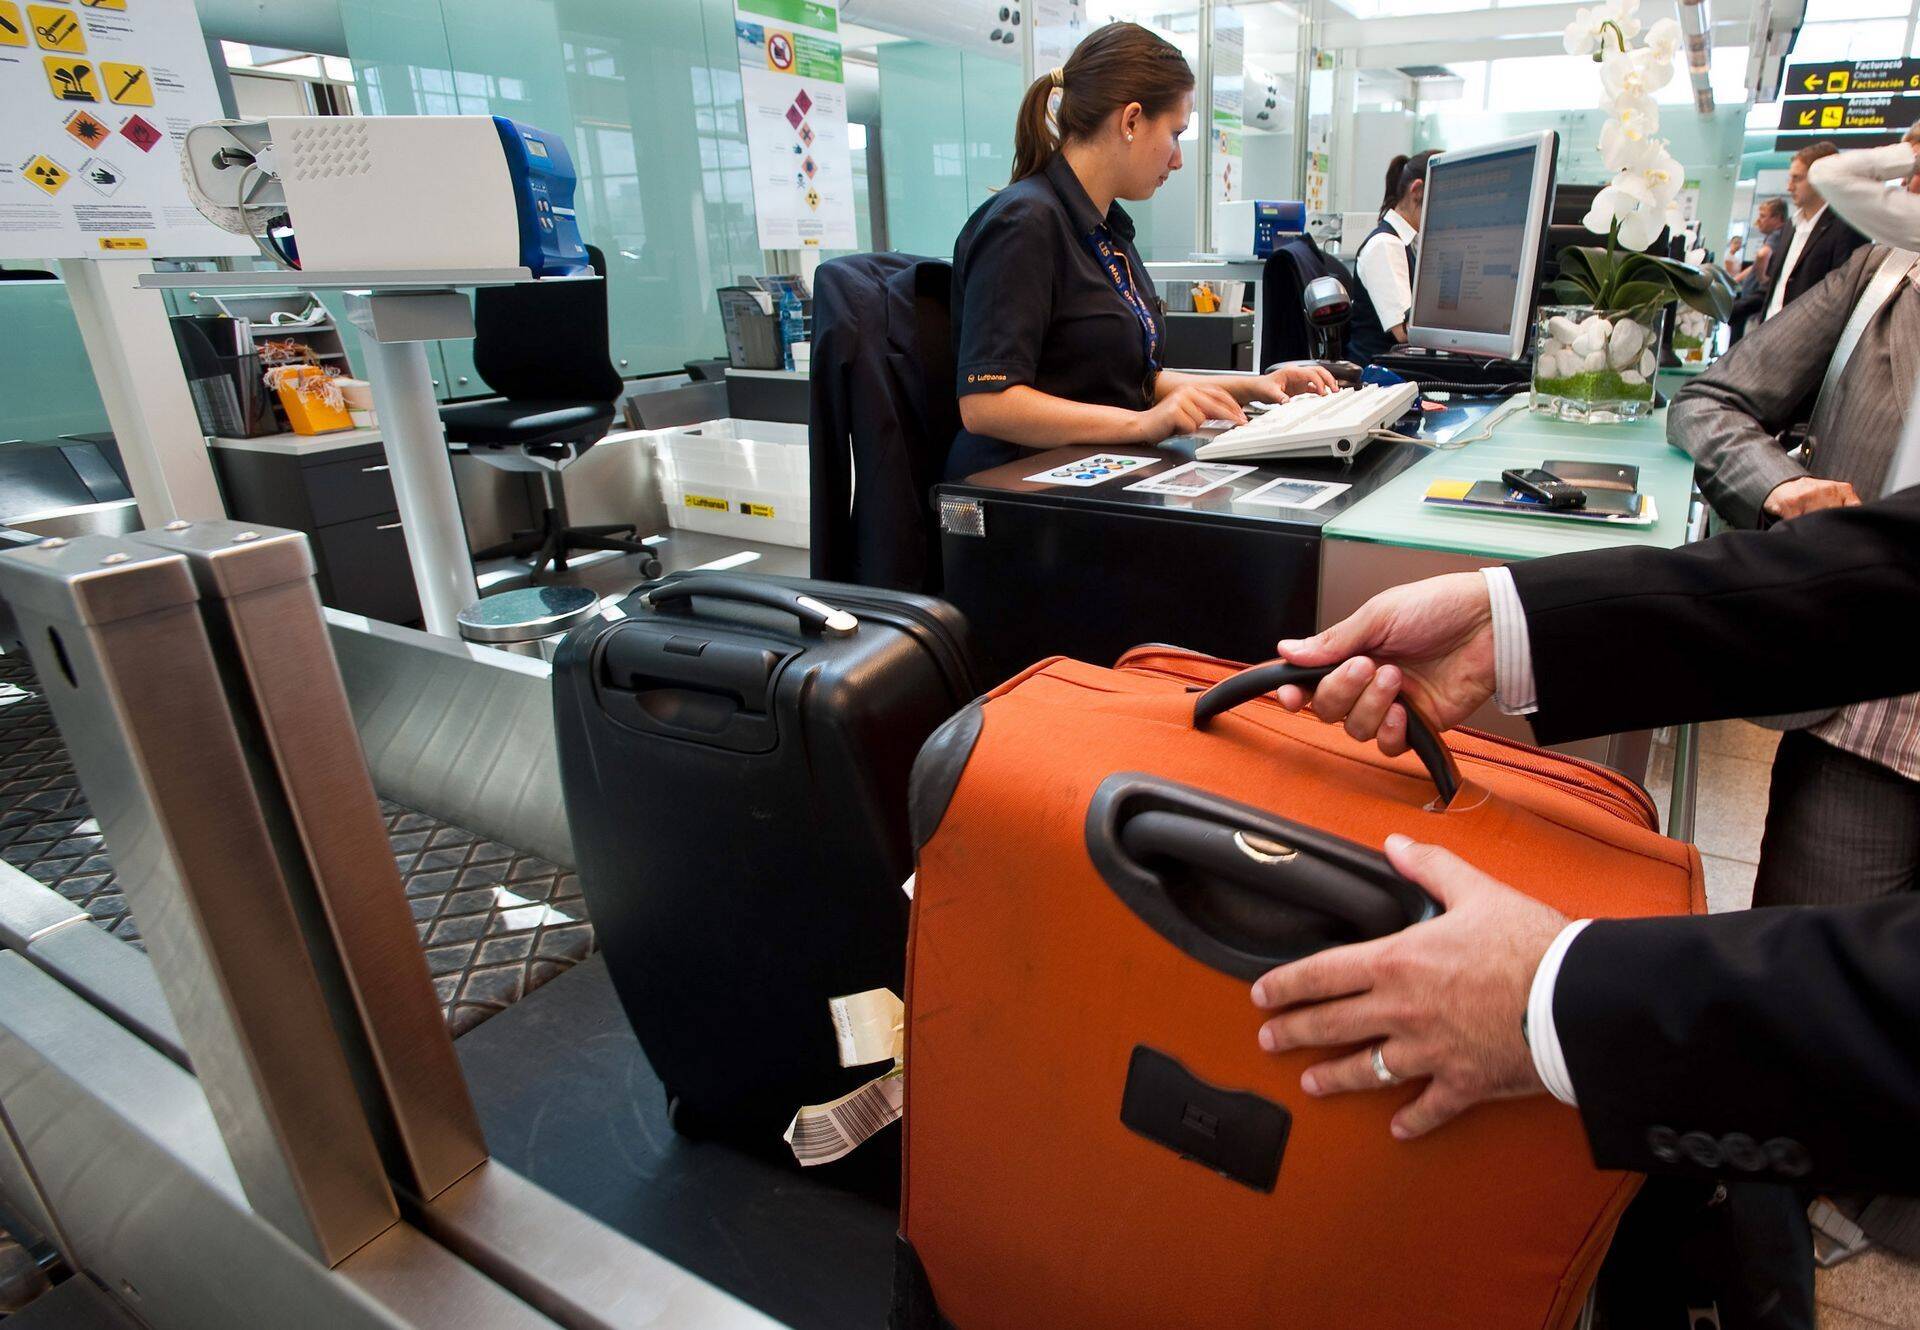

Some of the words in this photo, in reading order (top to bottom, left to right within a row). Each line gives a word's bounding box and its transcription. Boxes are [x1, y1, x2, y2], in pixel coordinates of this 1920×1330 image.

[1852, 79, 1905, 89] Facturación
[1098, 241, 1111, 257] LIS
[1109, 264, 1122, 284] MAD
